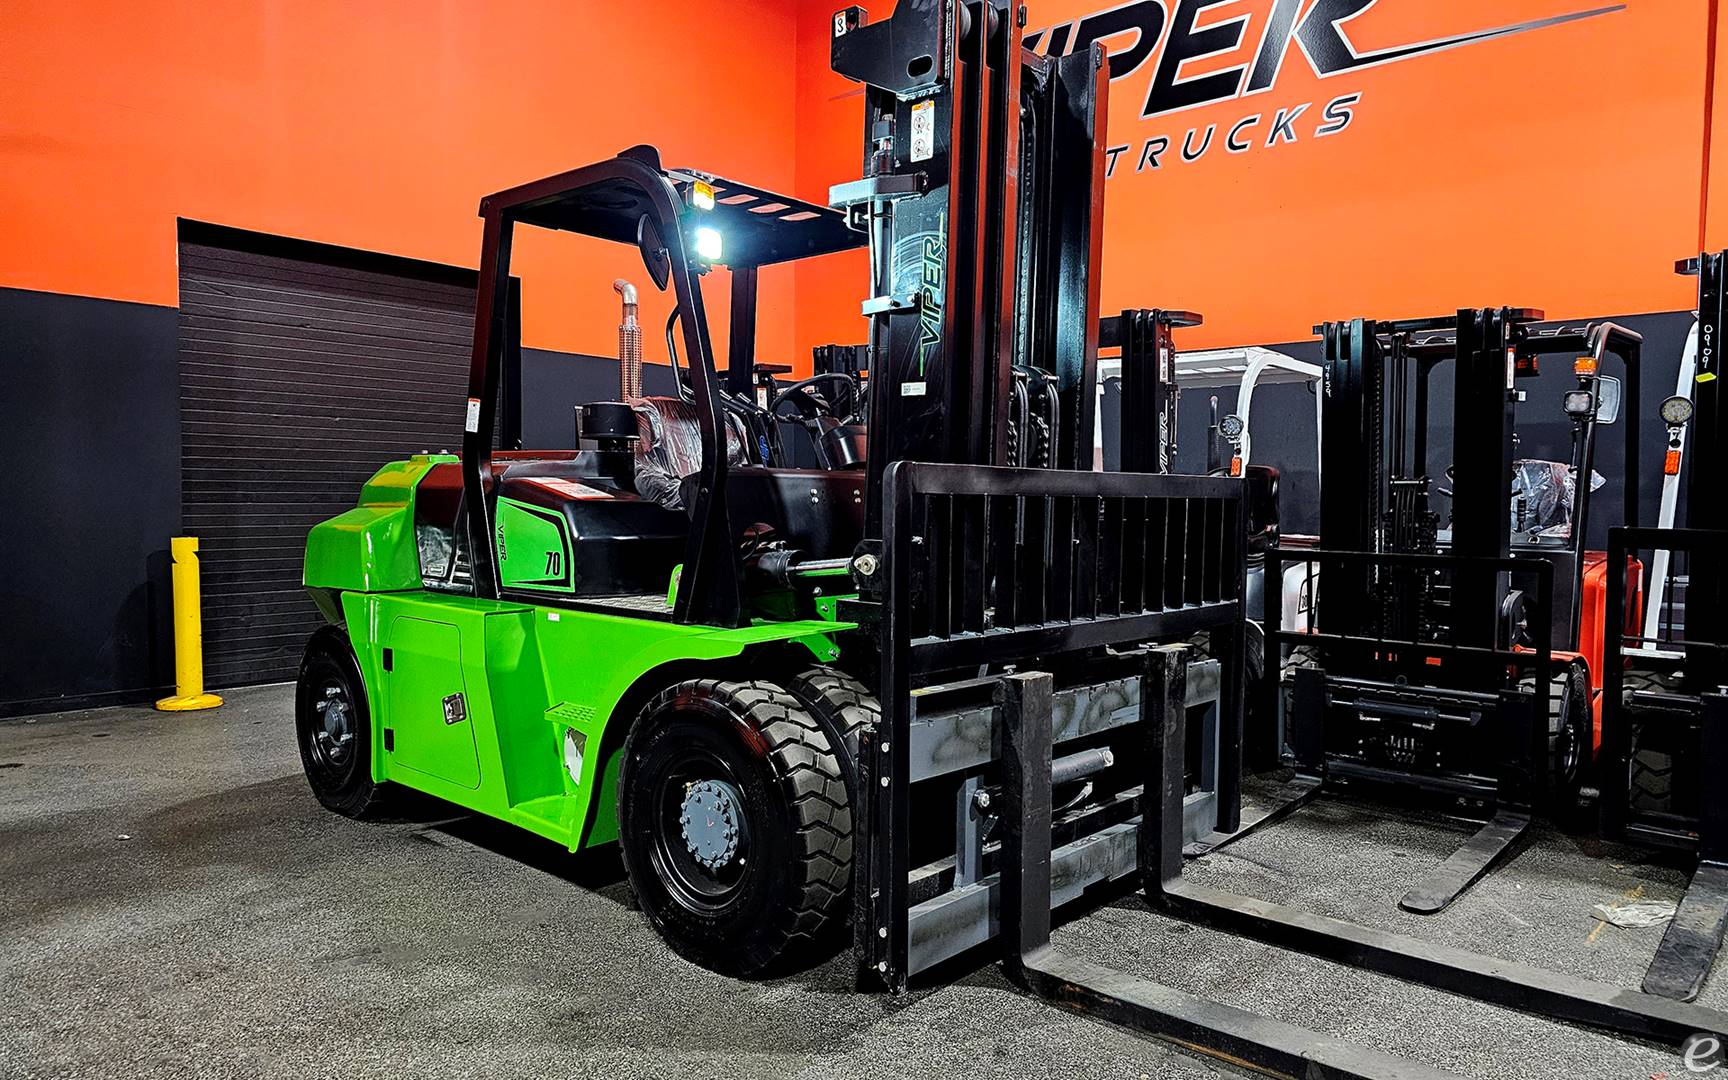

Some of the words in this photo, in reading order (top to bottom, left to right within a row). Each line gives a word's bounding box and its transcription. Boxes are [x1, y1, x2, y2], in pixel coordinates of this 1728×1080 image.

[1105, 91, 1363, 178] TRUCKS
[921, 236, 943, 346] VIPER
[1702, 324, 1713, 369] 0909
[497, 525, 507, 561] VIPER
[545, 551, 561, 576] 70
